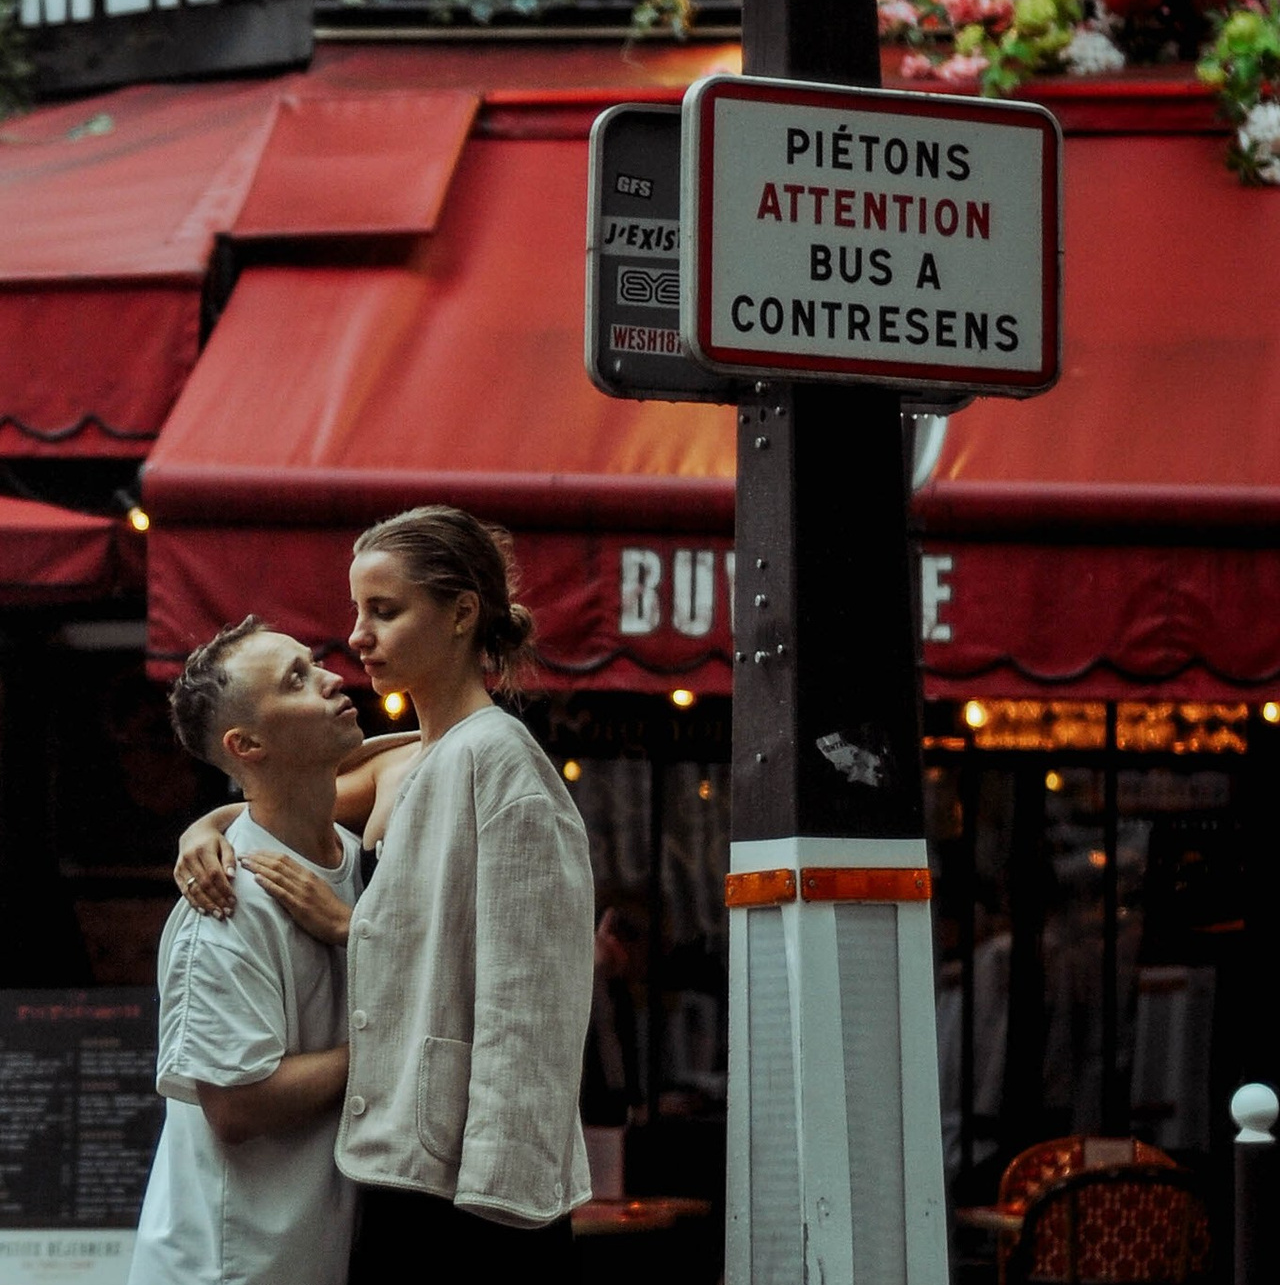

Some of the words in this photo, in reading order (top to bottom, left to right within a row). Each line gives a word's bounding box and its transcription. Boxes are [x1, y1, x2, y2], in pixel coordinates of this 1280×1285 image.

[786, 124, 971, 182] PIÉTONS
[616, 175, 652, 197] GFS
[756, 182, 992, 241] ATTENTION
[604, 222, 680, 252] J'EXIS
[810, 244, 893, 287] BUS
[915, 252, 942, 291] A
[730, 295, 1019, 353] CONTRESENS
